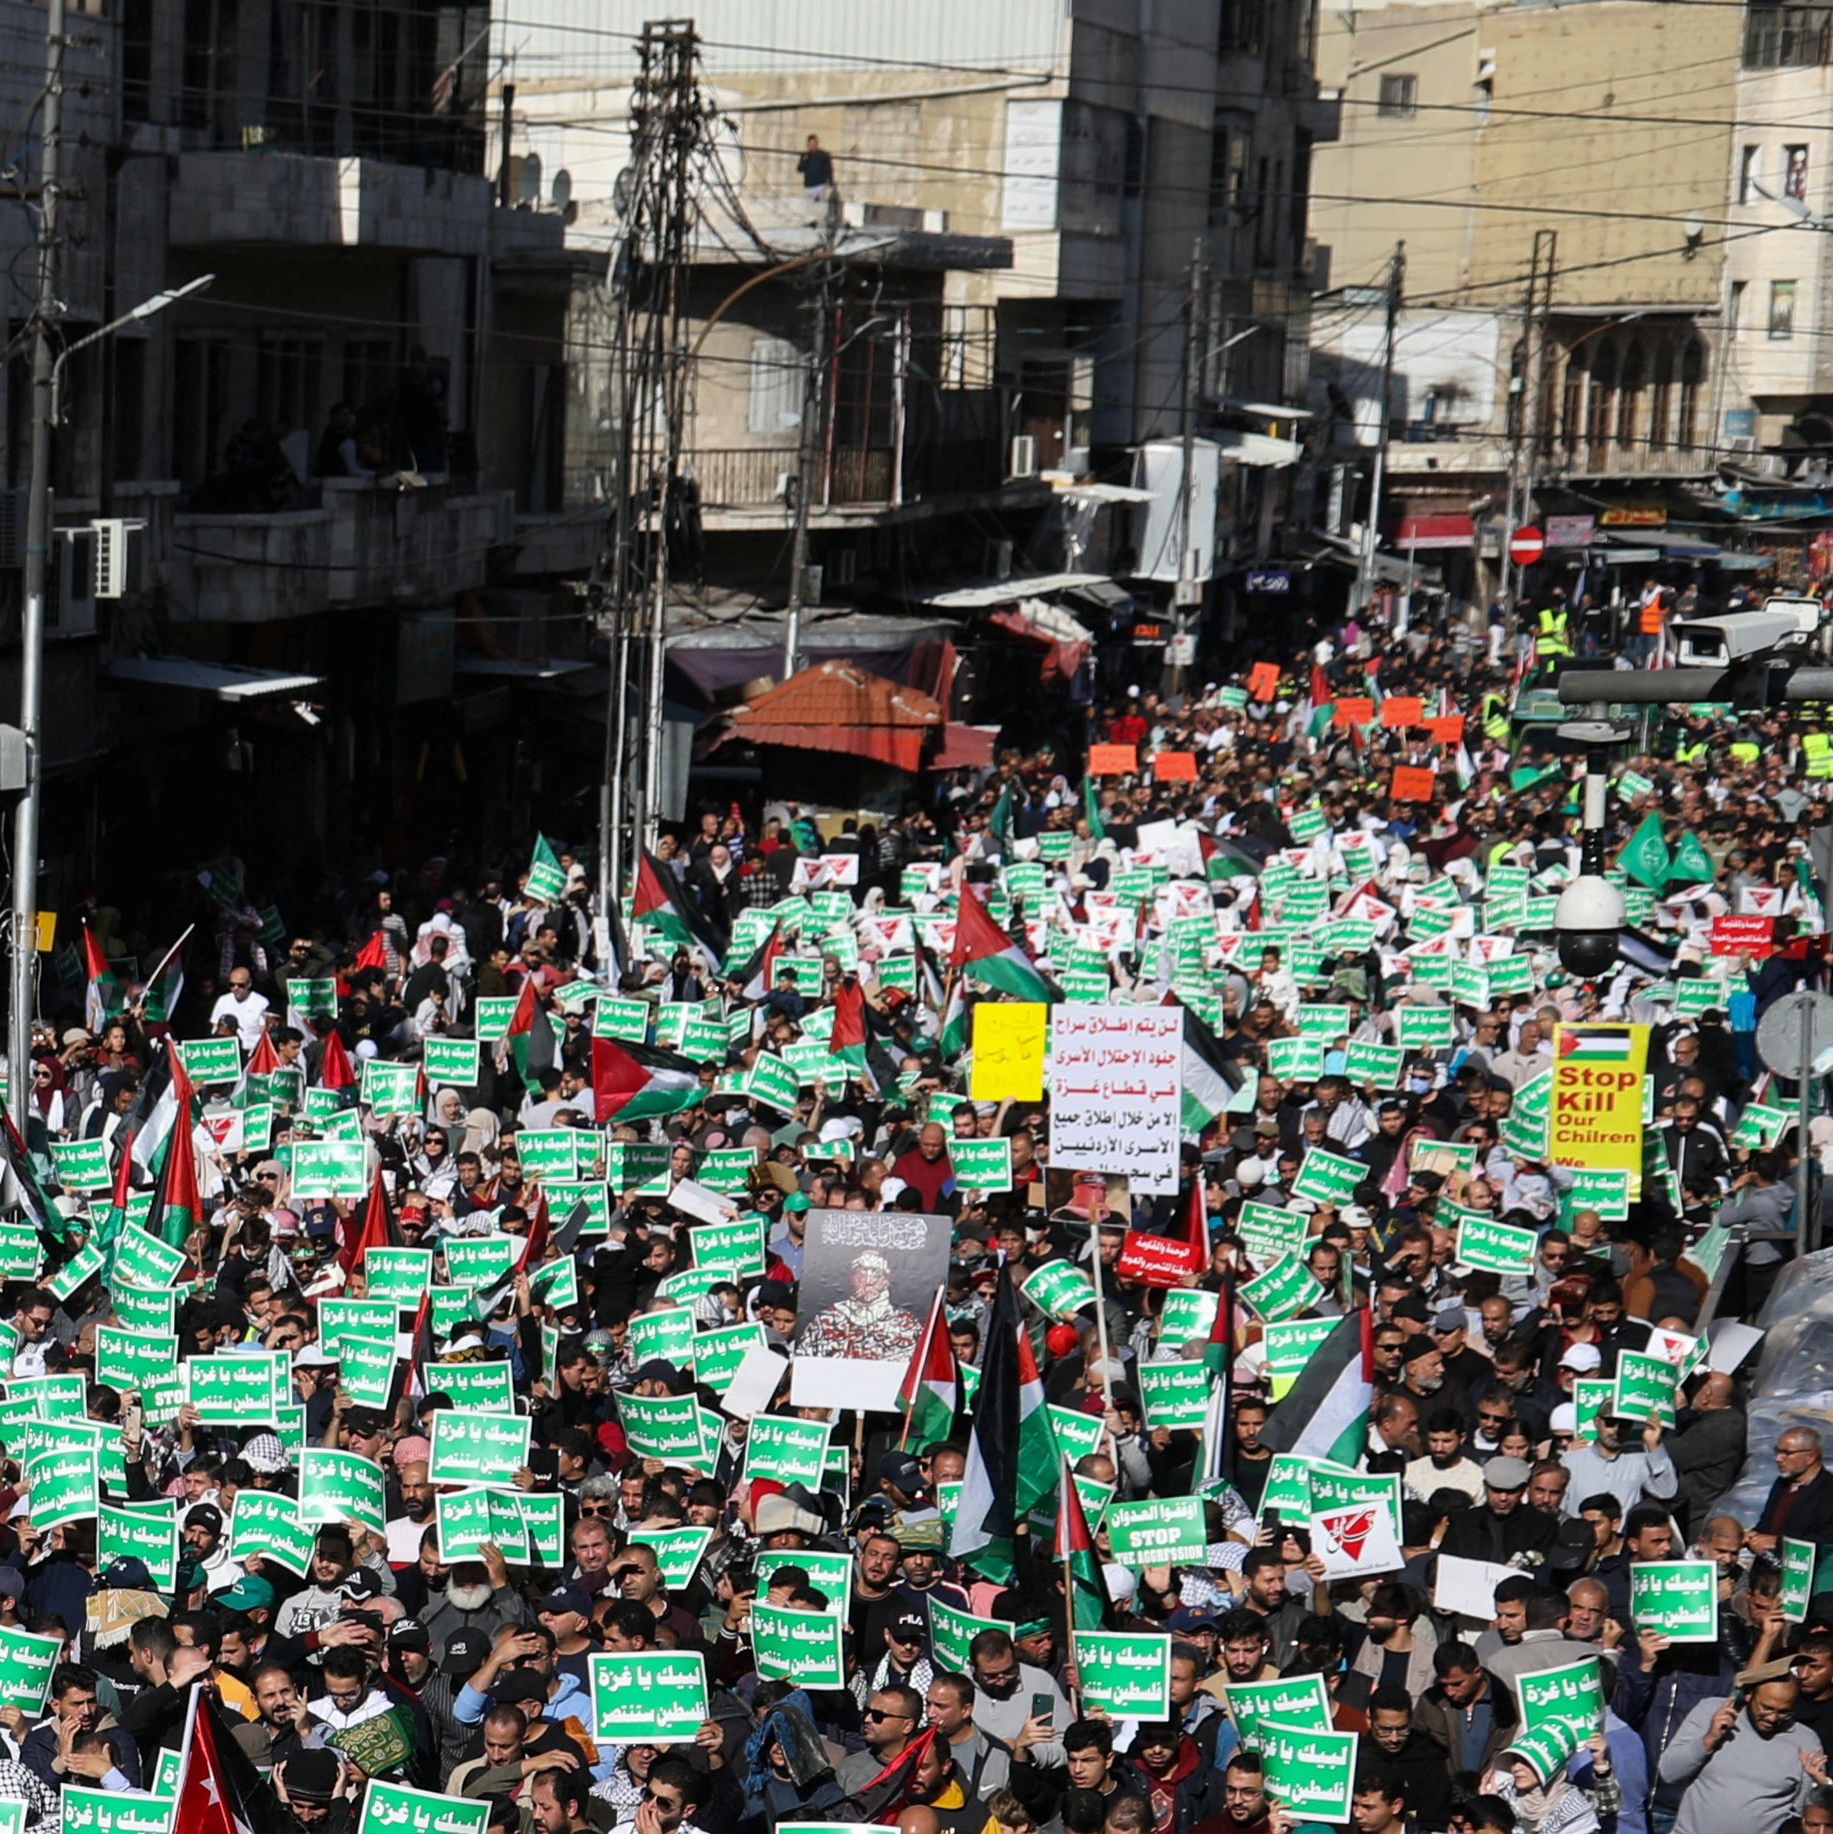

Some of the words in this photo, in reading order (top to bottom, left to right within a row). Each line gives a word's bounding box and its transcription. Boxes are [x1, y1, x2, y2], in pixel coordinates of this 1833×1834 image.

[1056, 1016, 1086, 1036] سراح
[1088, 1015, 1134, 1036] إطلاق
[1135, 1017, 1157, 1037] يتم
[1158, 1017, 1178, 1036] لن
[1056, 1078, 1101, 1097] غزة
[1558, 1066, 1638, 1092] Stop
[1103, 1081, 1148, 1101] قطاع
[1149, 1083, 1176, 1103] في
[1557, 1092, 1615, 1112] Kill
[1053, 1111, 1082, 1130] جميع
[1083, 1109, 1117, 1129] إطلاق
[1118, 1109, 1144, 1129] خلال
[1145, 1112, 1162, 1129] من
[1556, 1113, 1597, 1126] Our
[1055, 1137, 1124, 1156] الأردنيين
[1125, 1138, 1176, 1156] الأسرى
[1556, 1130, 1637, 1144] Chilren
[1554, 1156, 1586, 1168] We
[1153, 1164, 1174, 1187] في
[1111, 1505, 1158, 1528] العدوان
[1129, 1526, 1182, 1548] STOP
[1114, 1551, 1135, 1565] THE
[1137, 1544, 1203, 1564] AGGRESSION
[898, 1613, 924, 1626] FILA
